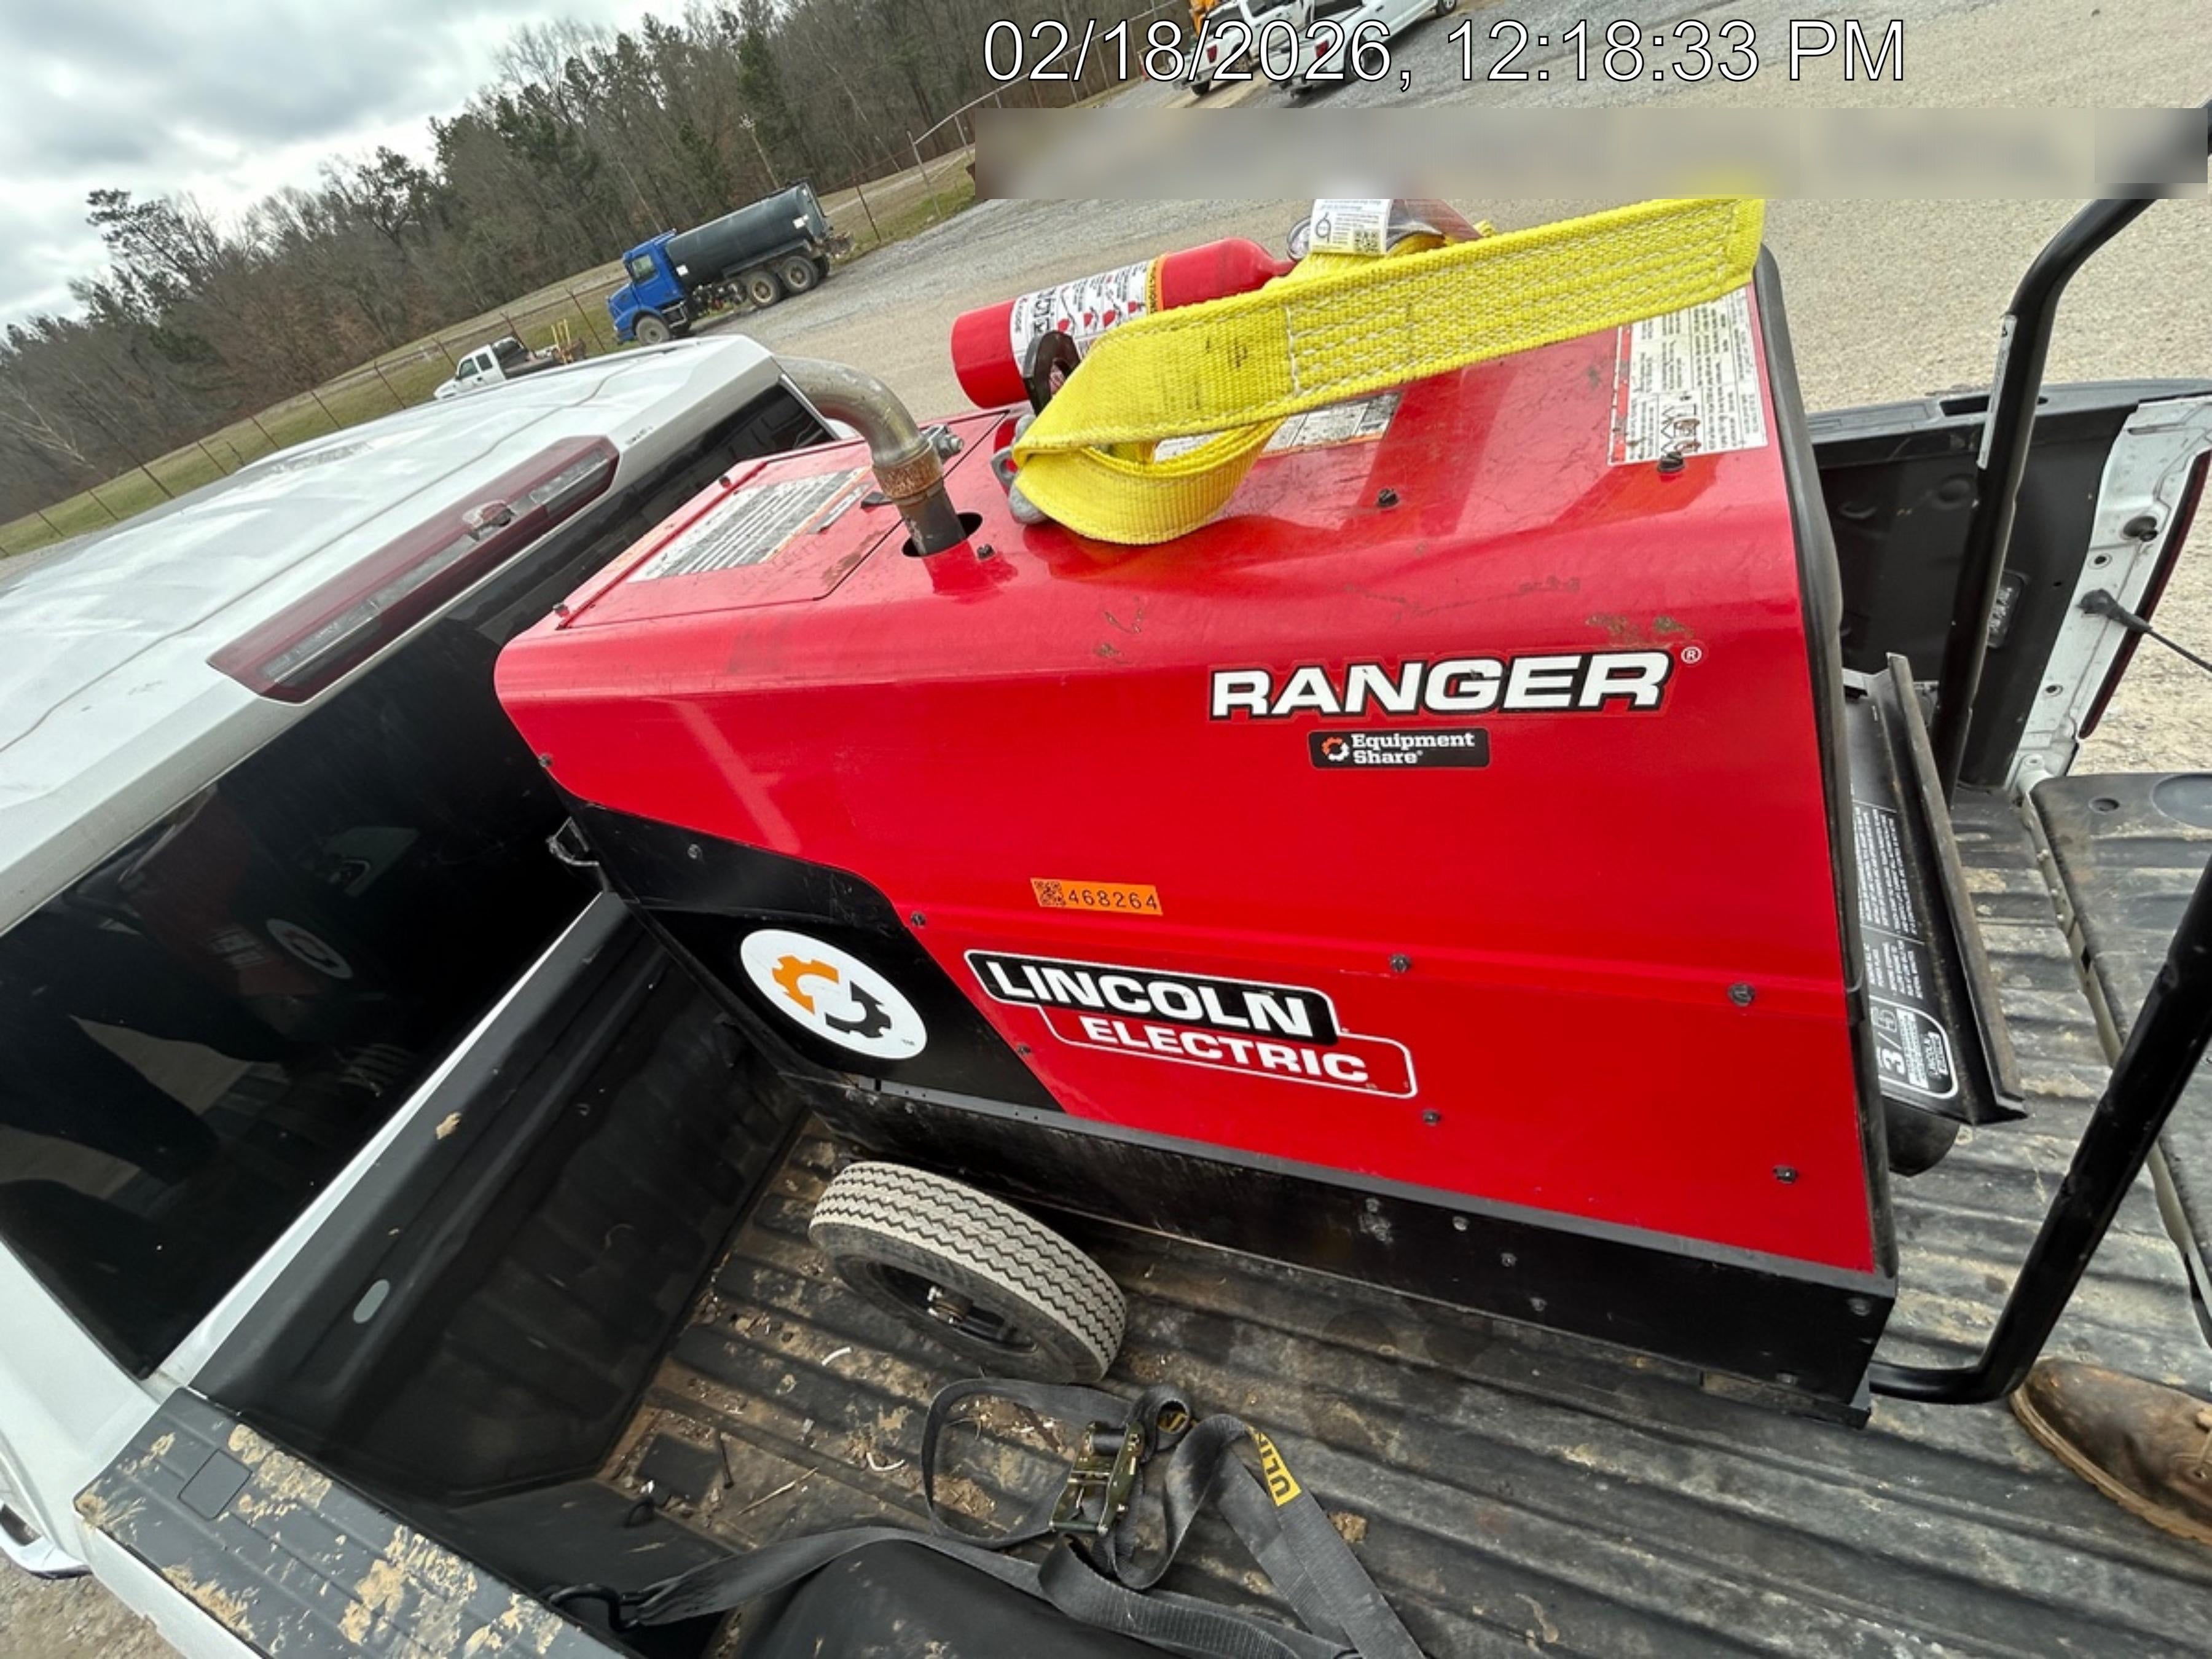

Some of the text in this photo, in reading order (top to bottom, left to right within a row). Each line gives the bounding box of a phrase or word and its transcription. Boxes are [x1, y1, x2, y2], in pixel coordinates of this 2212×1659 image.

[1211, 650, 1673, 719] RANGER
[1351, 732, 1475, 751] Equipment
[1069, 889, 1157, 910] 468264
[986, 960, 1313, 1037] LINCOLN
[1079, 1016, 1368, 1083] ELECTRIC
